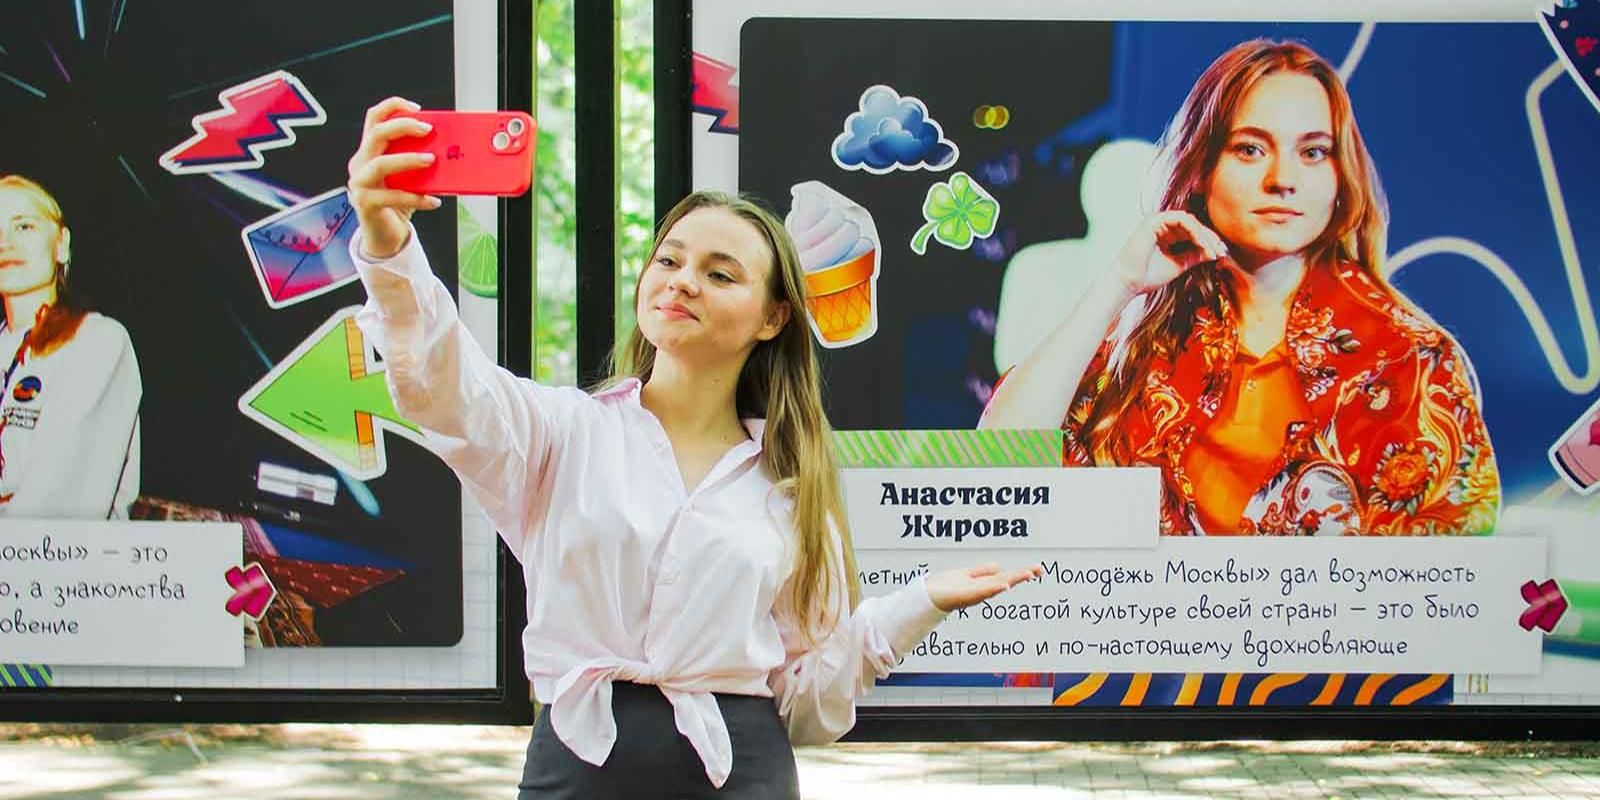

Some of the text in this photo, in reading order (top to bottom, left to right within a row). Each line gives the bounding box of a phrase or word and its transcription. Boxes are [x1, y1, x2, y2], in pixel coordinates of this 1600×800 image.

[880, 482, 1050, 506] Анастасия
[900, 515, 1029, 542] Жирова
[0, 535, 88, 561] осквы»
[132, 547, 168, 564] это
[30, 581, 43, 598] а
[54, 574, 185, 607] знакомства
[1026, 560, 1154, 596] Молодёжь
[1166, 558, 1271, 583] Москвы»
[1280, 568, 1318, 595] дал
[1329, 558, 1476, 592] возможность
[0, 608, 79, 635] овение
[982, 599, 1070, 620] богатой
[1081, 603, 1177, 627] культуре
[1187, 594, 1252, 619] своей
[1262, 602, 1337, 627] страны
[1377, 602, 1414, 619] это
[1424, 594, 1480, 619] было
[898, 629, 1408, 667] авательно и по-настоящему вдохновляюще
